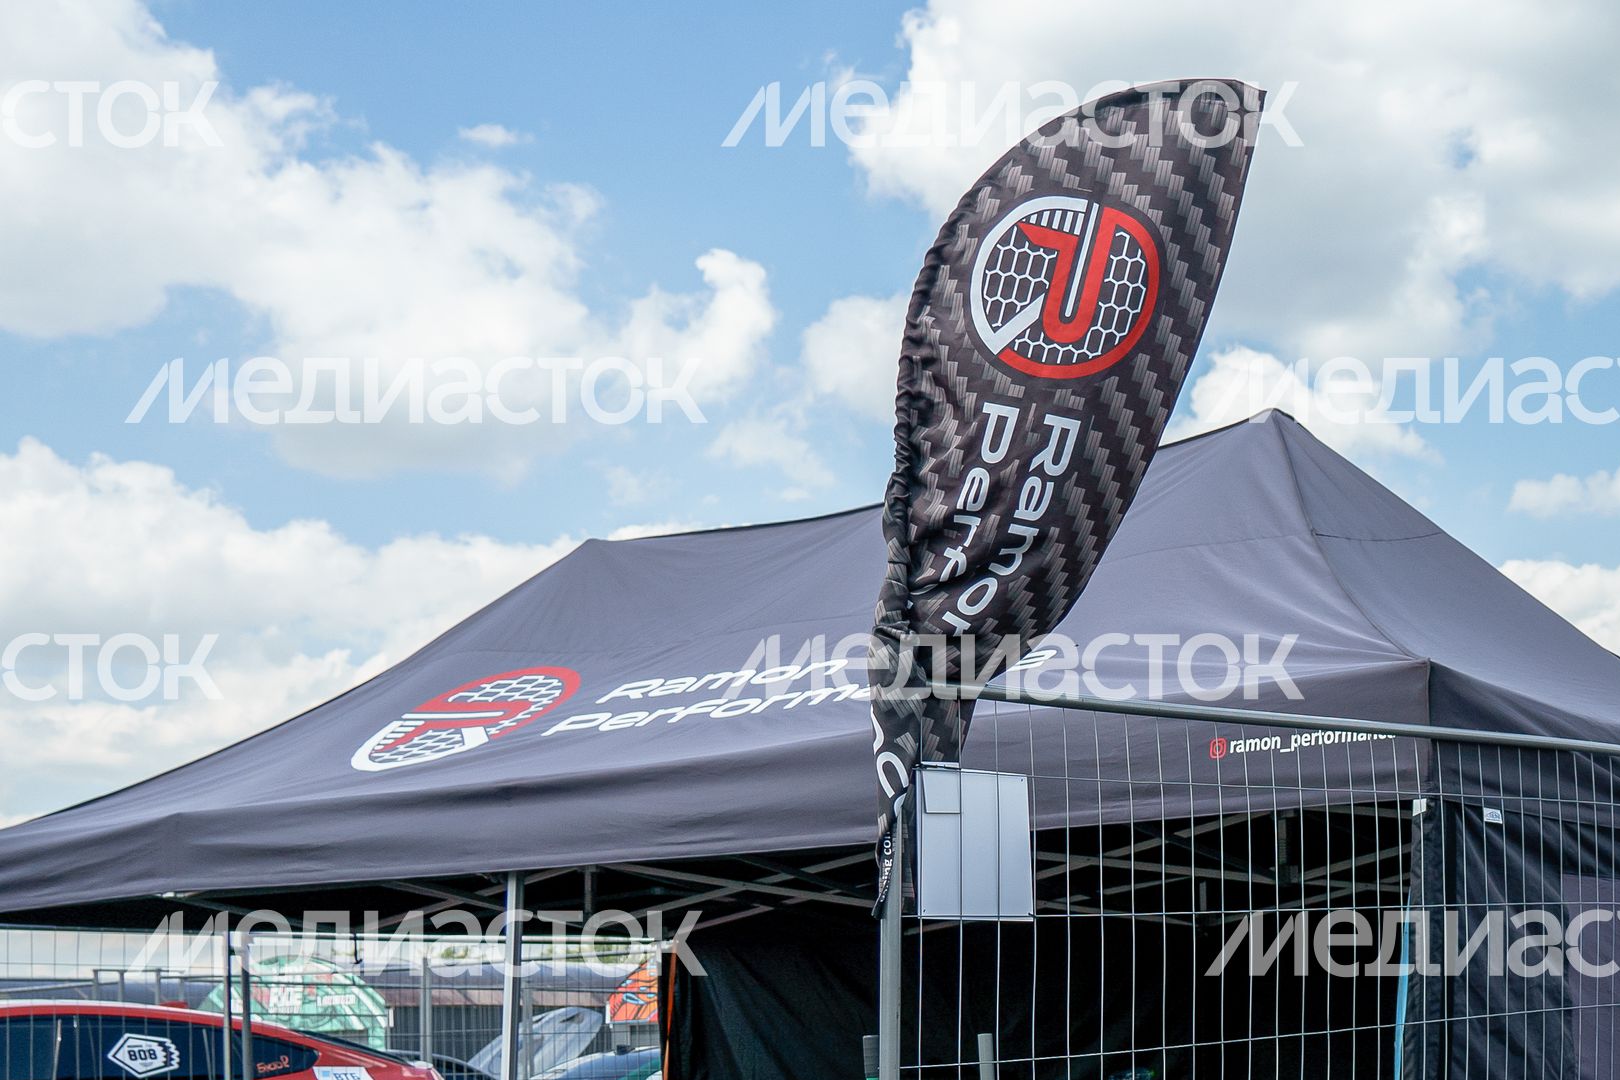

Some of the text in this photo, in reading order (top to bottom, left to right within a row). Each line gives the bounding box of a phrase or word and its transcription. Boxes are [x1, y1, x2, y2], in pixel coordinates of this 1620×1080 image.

[595, 659, 848, 704] Ramon
[128, 1049, 157, 1061] 808
[333, 1072, 361, 1080] ВТБ
